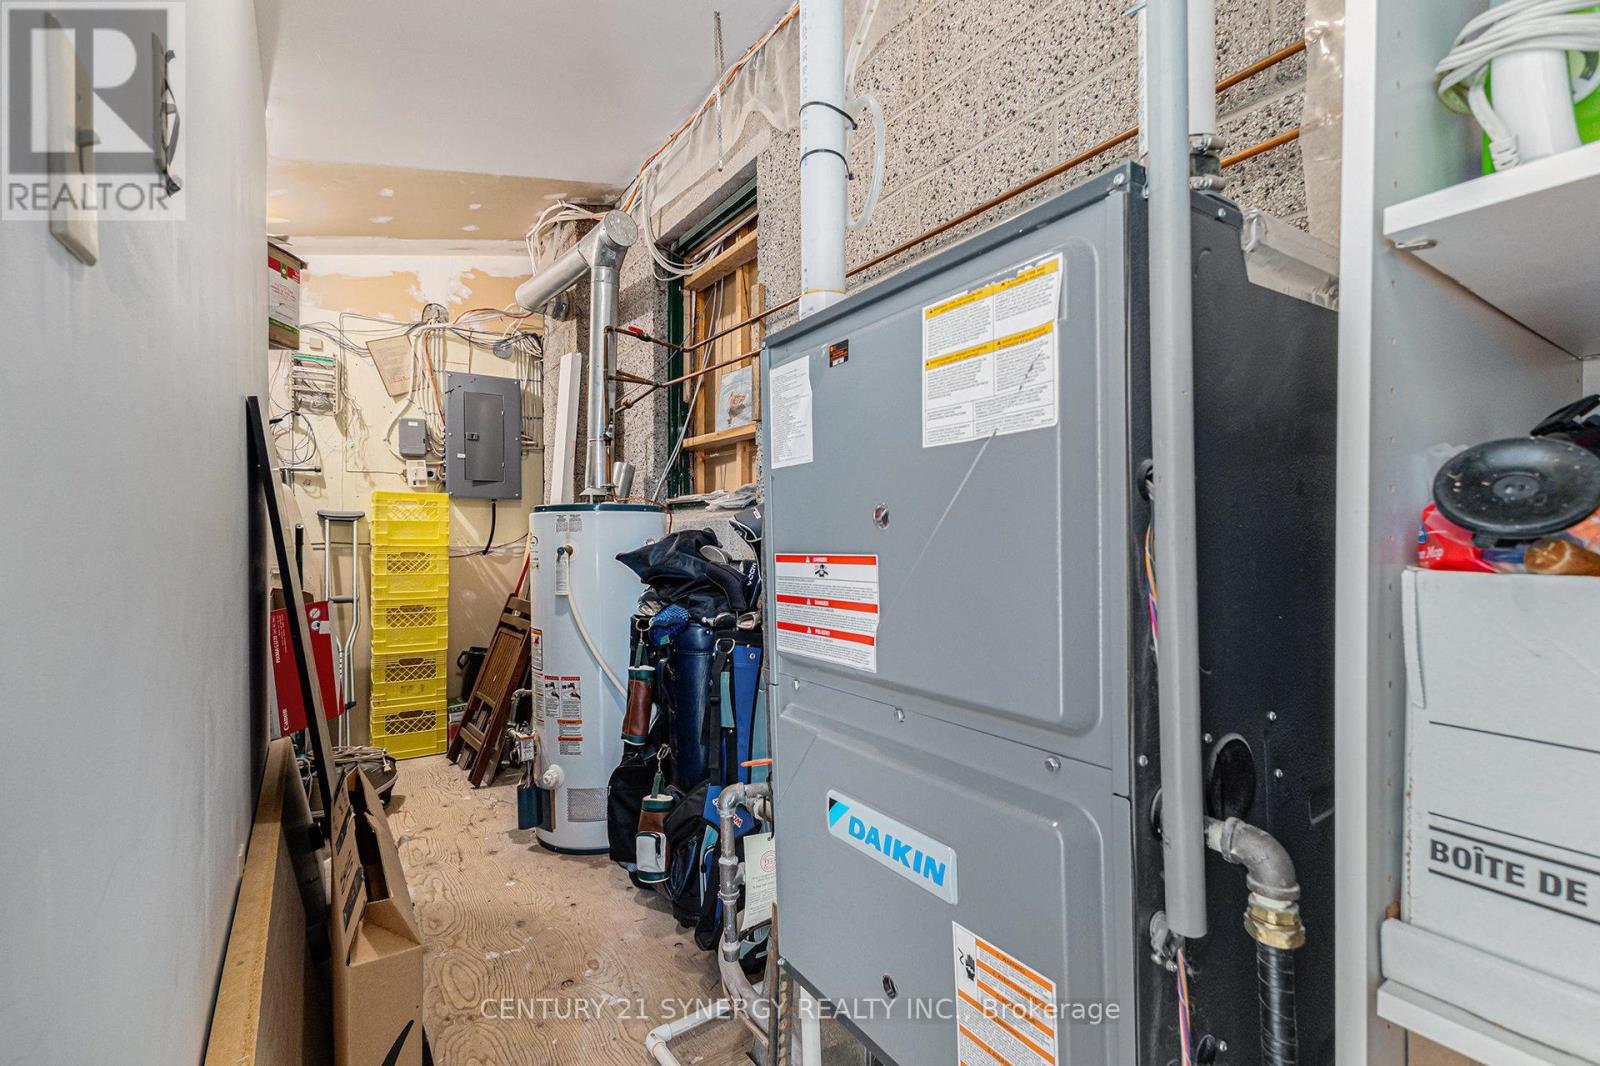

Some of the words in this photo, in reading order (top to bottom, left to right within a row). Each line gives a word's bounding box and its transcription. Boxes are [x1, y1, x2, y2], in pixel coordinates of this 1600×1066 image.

[848, 815, 946, 887] DAIKIN
[1430, 838, 1525, 888] BOÎTE
[1538, 869, 1588, 907] DE
